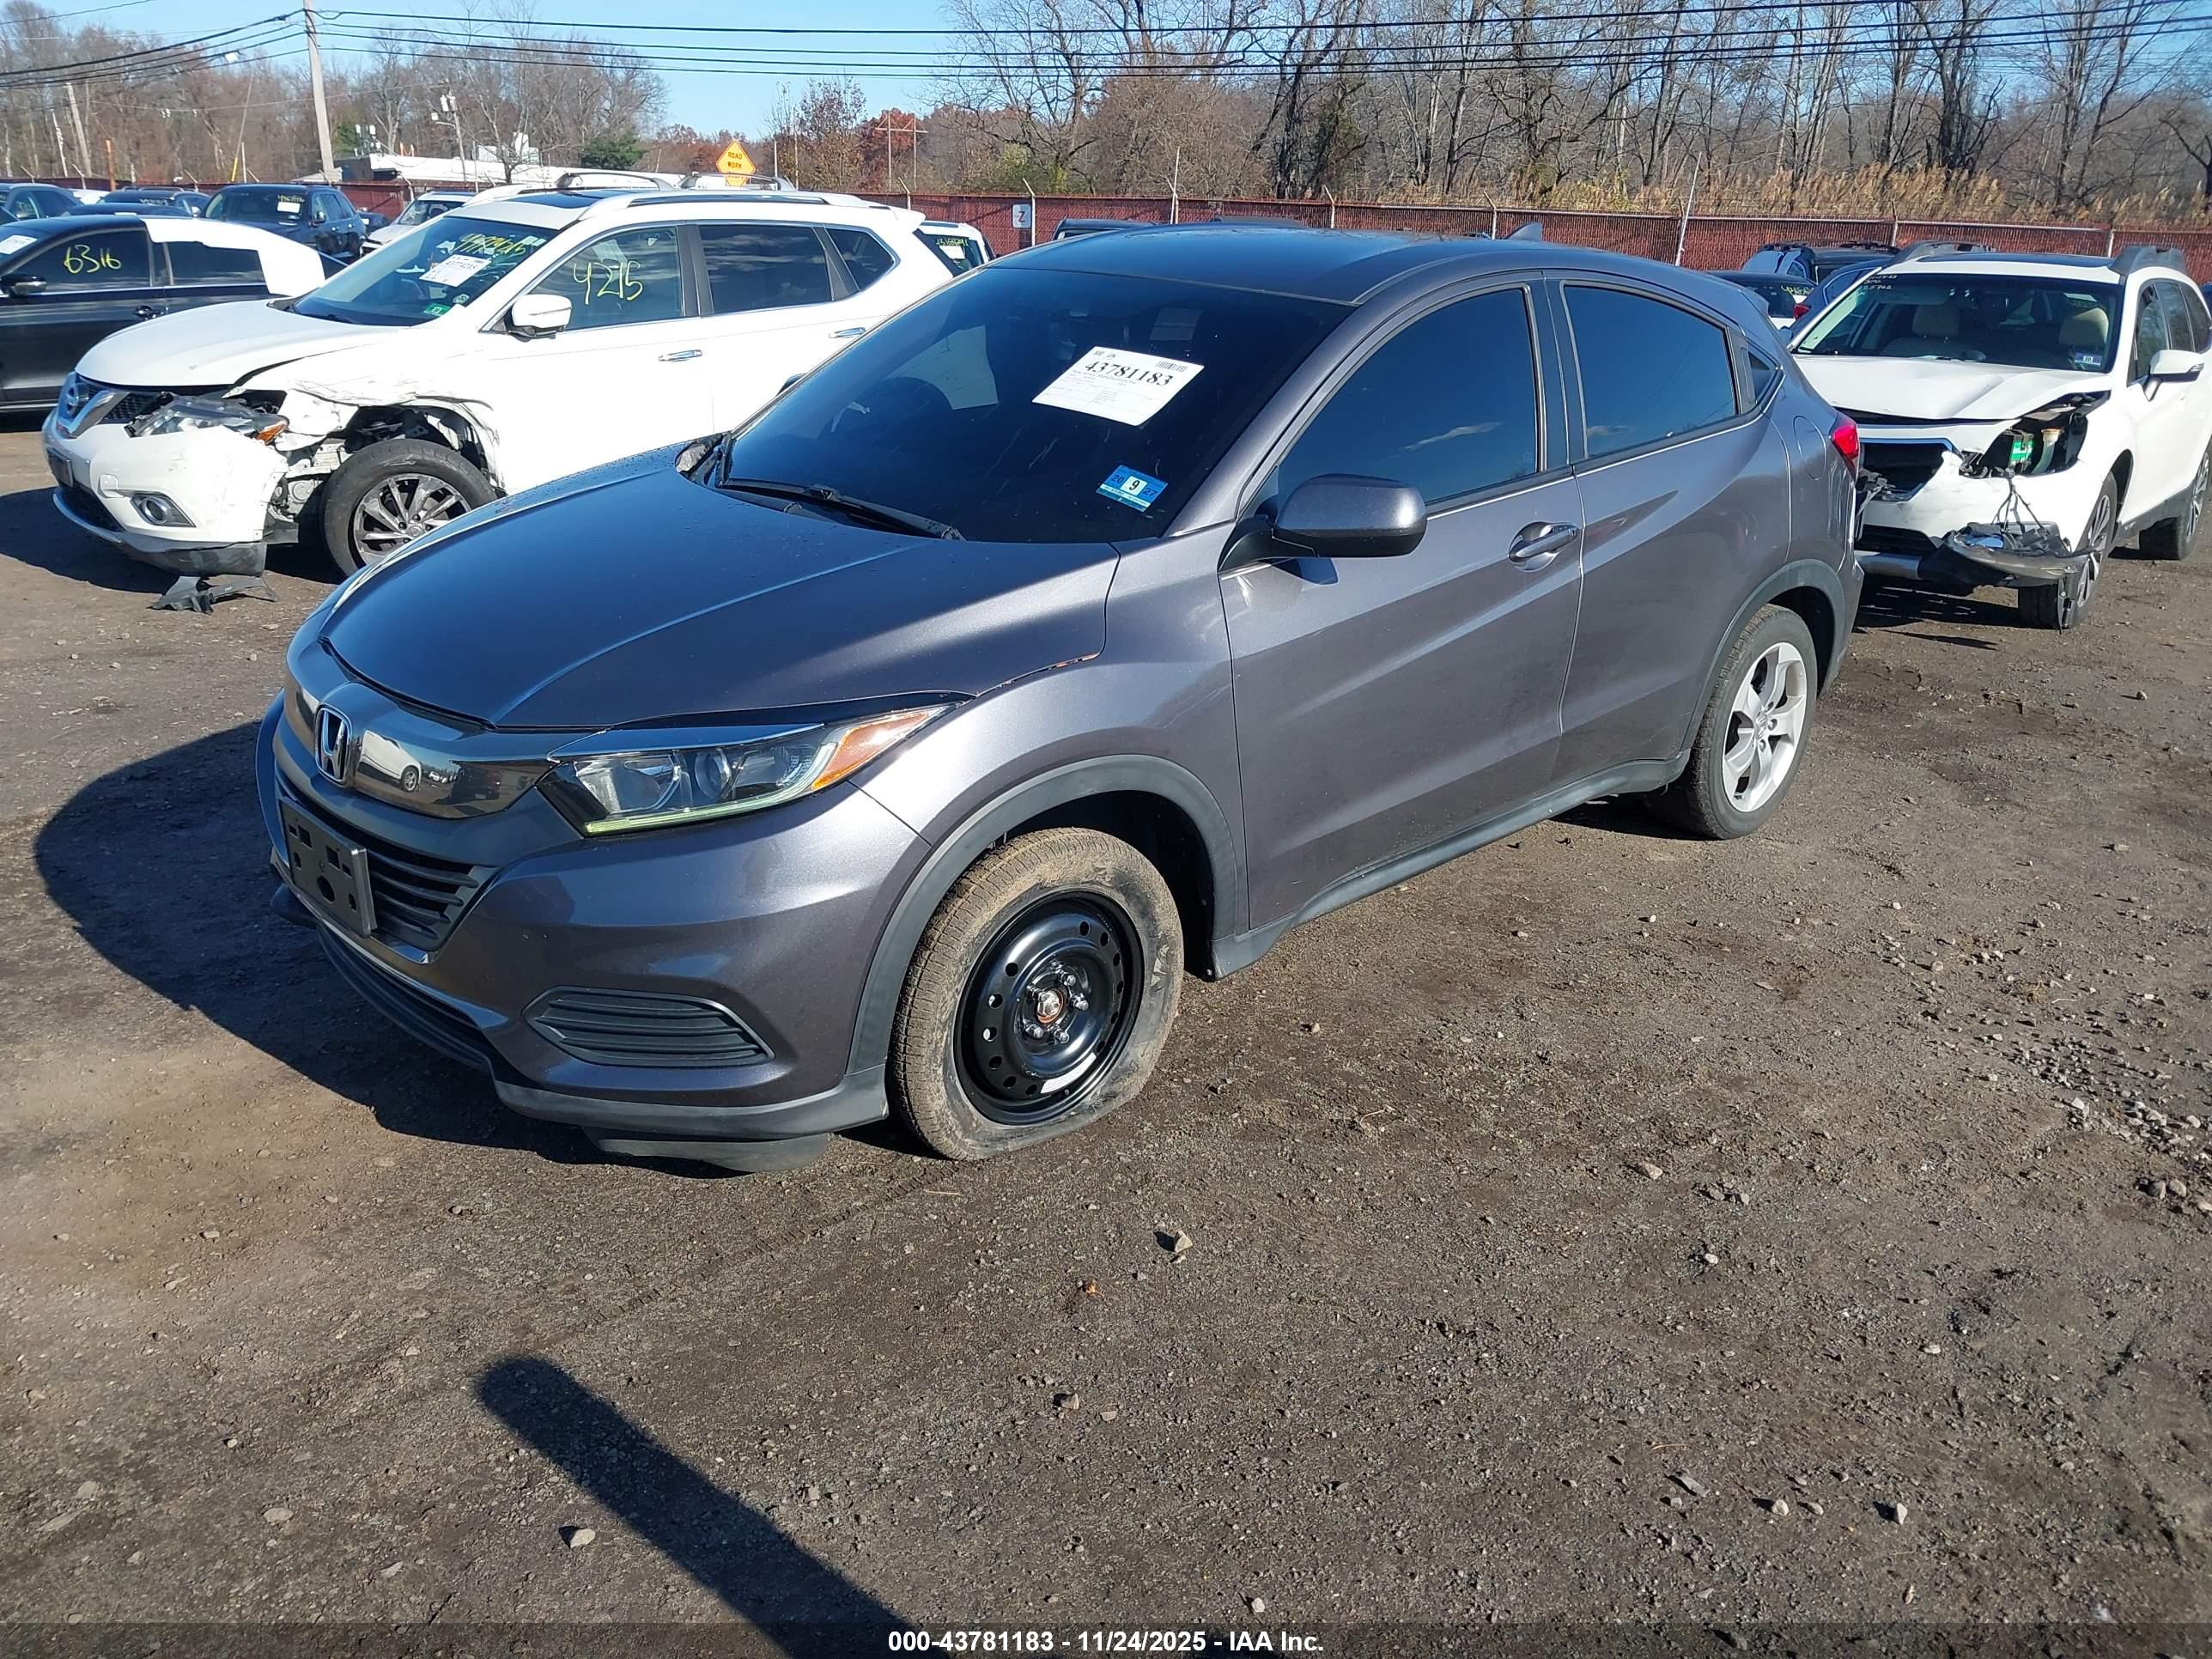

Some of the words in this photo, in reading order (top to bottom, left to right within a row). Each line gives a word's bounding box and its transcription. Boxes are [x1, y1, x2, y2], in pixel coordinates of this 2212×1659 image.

[727, 161, 742, 170] WORK
[64, 245, 122, 273] 6316
[573, 260, 643, 305] 4215
[1085, 361, 1174, 386] 43781183
[1111, 474, 1125, 484] 20
[1129, 479, 1140, 491] 9
[1143, 487, 1158, 497] 27
